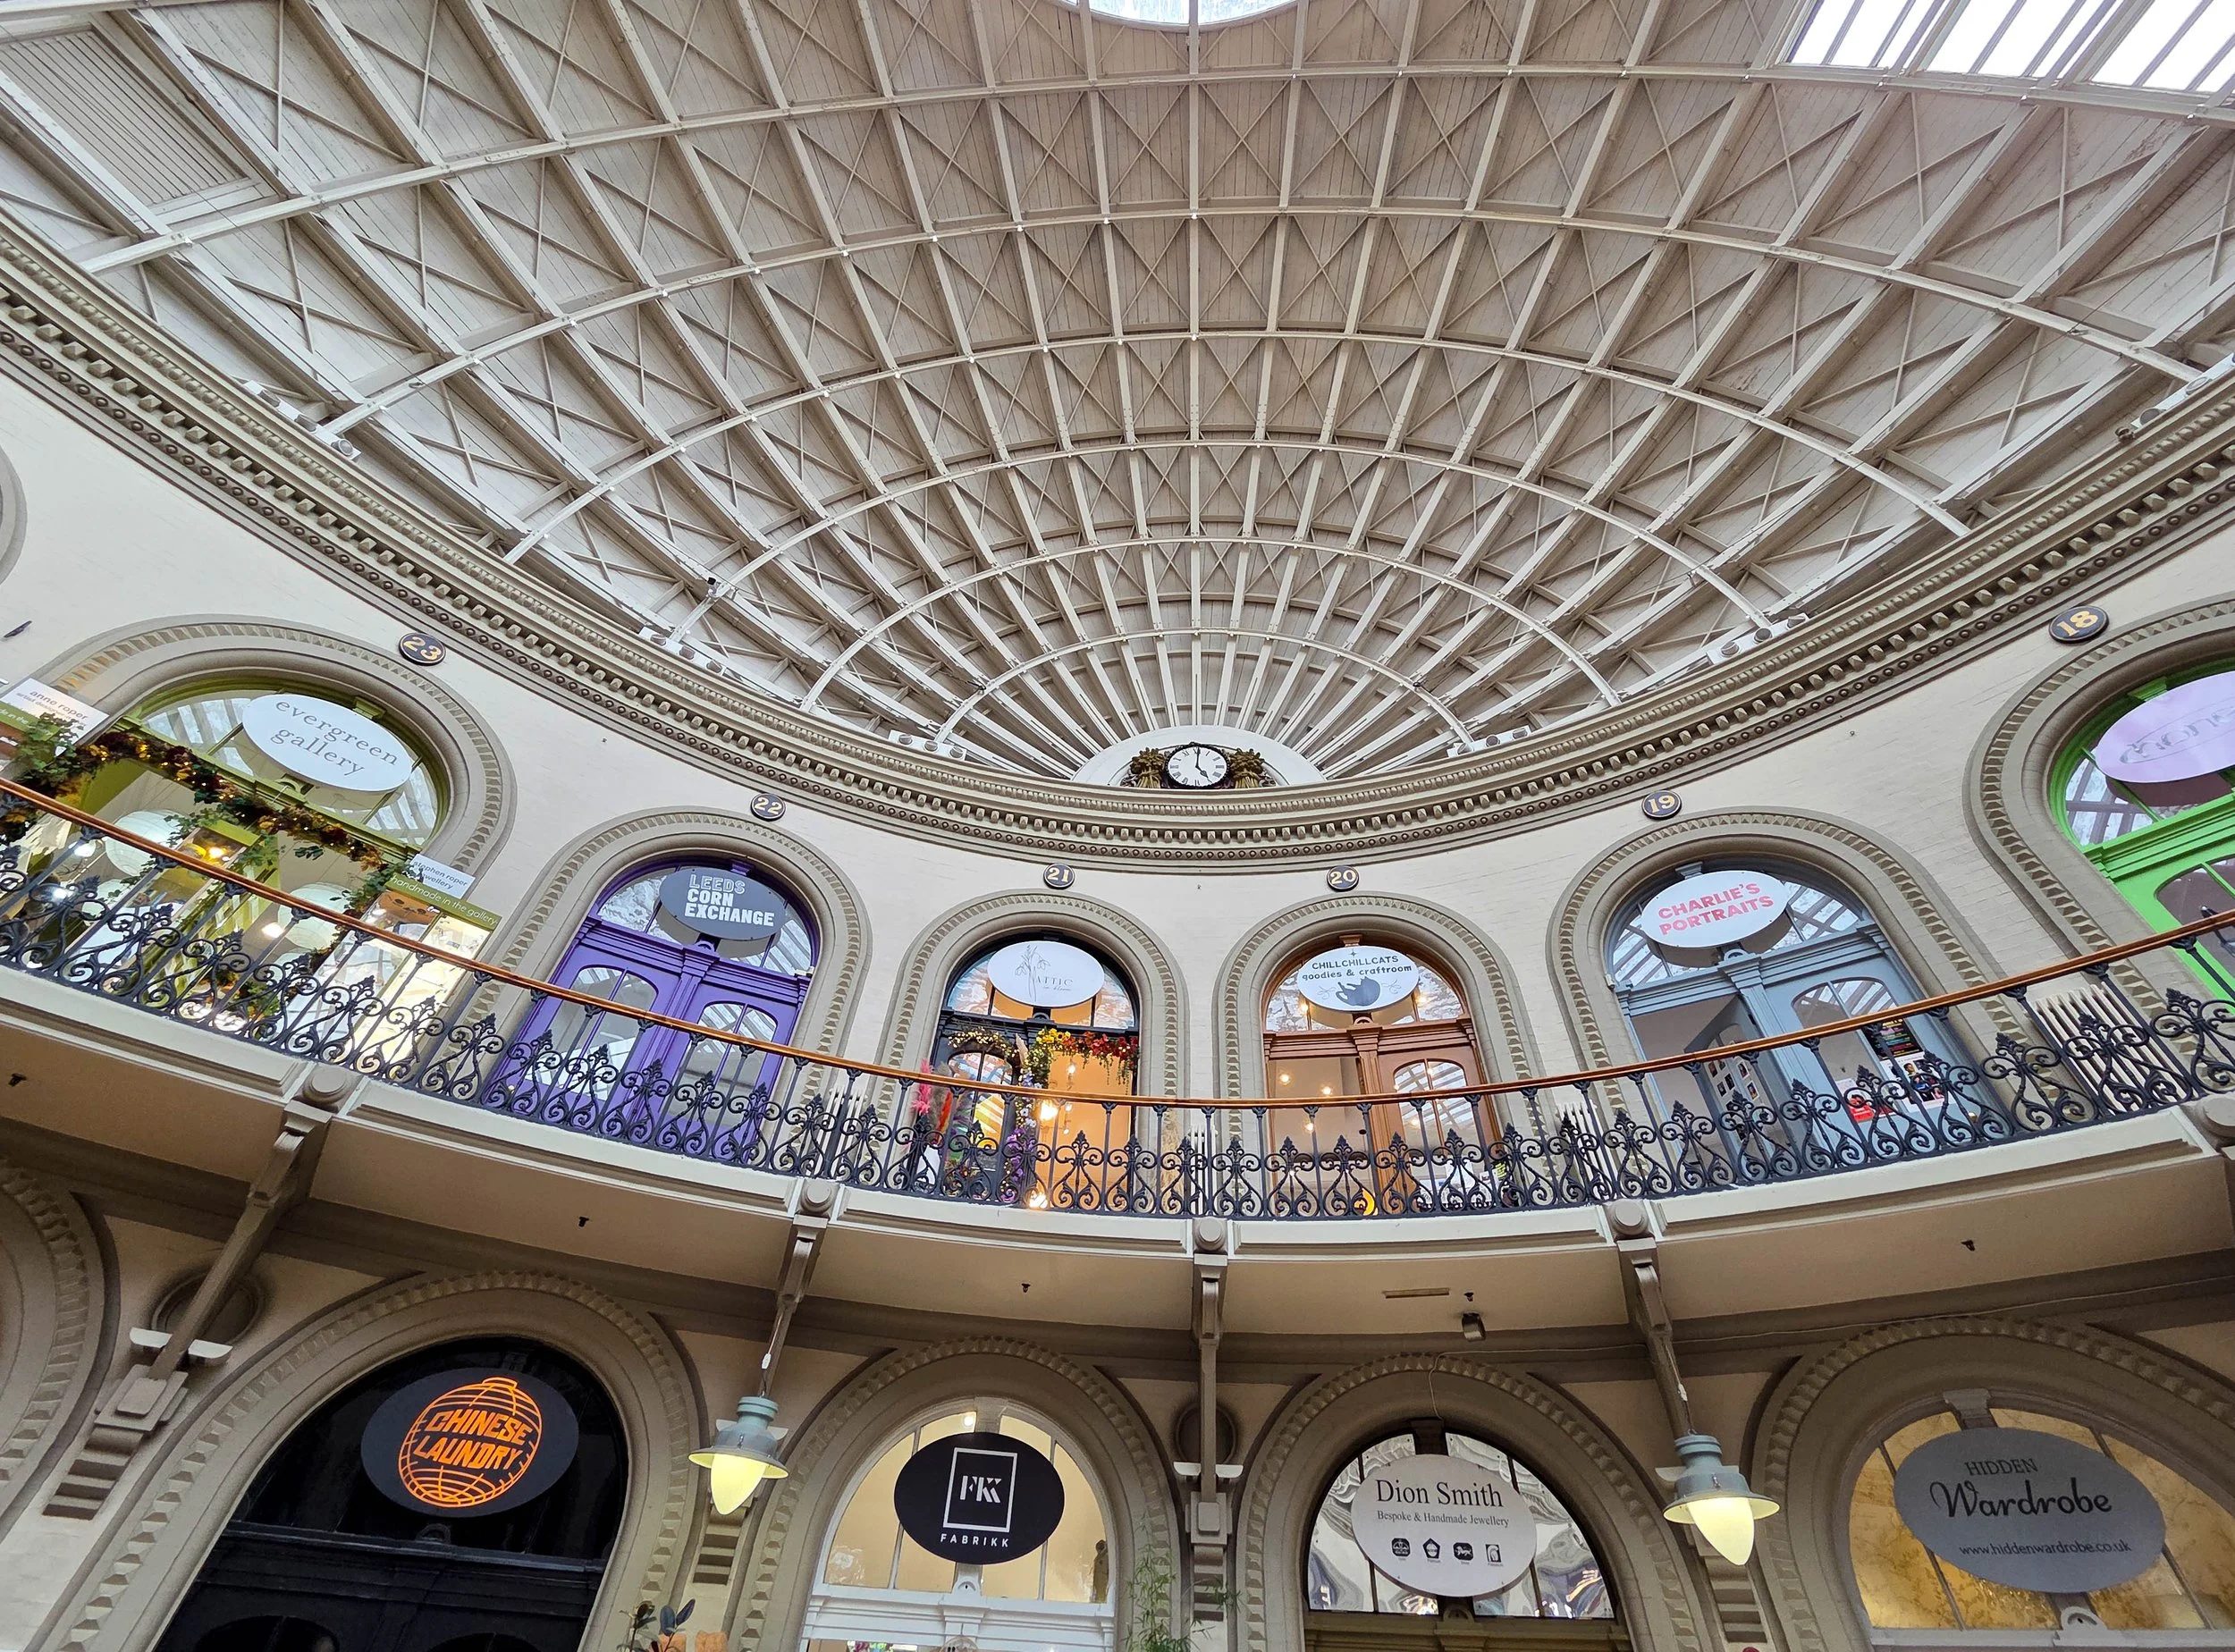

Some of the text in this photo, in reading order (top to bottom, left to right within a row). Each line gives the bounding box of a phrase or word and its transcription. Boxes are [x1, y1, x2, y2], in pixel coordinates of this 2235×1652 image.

[2057, 611, 2099, 636] 18
[403, 636, 442, 661] 23
[30, 690, 89, 721] anne roper
[275, 701, 398, 766] evergreen
[270, 729, 365, 776] gallery
[754, 796, 782, 815] 22
[1649, 795, 1675, 813] 19
[413, 861, 468, 887] stephen roper
[421, 872, 453, 890] wellery
[688, 873, 746, 894] LEEDS
[1047, 867, 1070, 882] 21
[1329, 870, 1356, 884] 20
[391, 875, 442, 901] handmade
[442, 898, 451, 906] in
[451, 901, 468, 912] the
[687, 889, 734, 906] CORN
[1658, 882, 1760, 919] CHARLIE'S
[685, 903, 775, 927] EXCHANGE
[1659, 896, 1774, 935] PORTRAITS
[1302, 965, 1413, 981] goodies & craftroom
[1311, 955, 1399, 970] CHILLCHILLCATS
[1036, 975, 1073, 986] ATTIC
[424, 1408, 533, 1446] CHINESE
[413, 1435, 523, 1471] LAUNDRY
[1965, 1458, 2038, 1476] HIDDEN
[1375, 1479, 1504, 1507] Dion Smith
[1929, 1477, 2113, 1518] Wardrobe
[1377, 1510, 1509, 1528] Bespoke & Handmade Jewellery
[940, 1533, 1008, 1547] FABRIKK
[1959, 1539, 2132, 1555] www.hiddenwardrobe.co.uk
